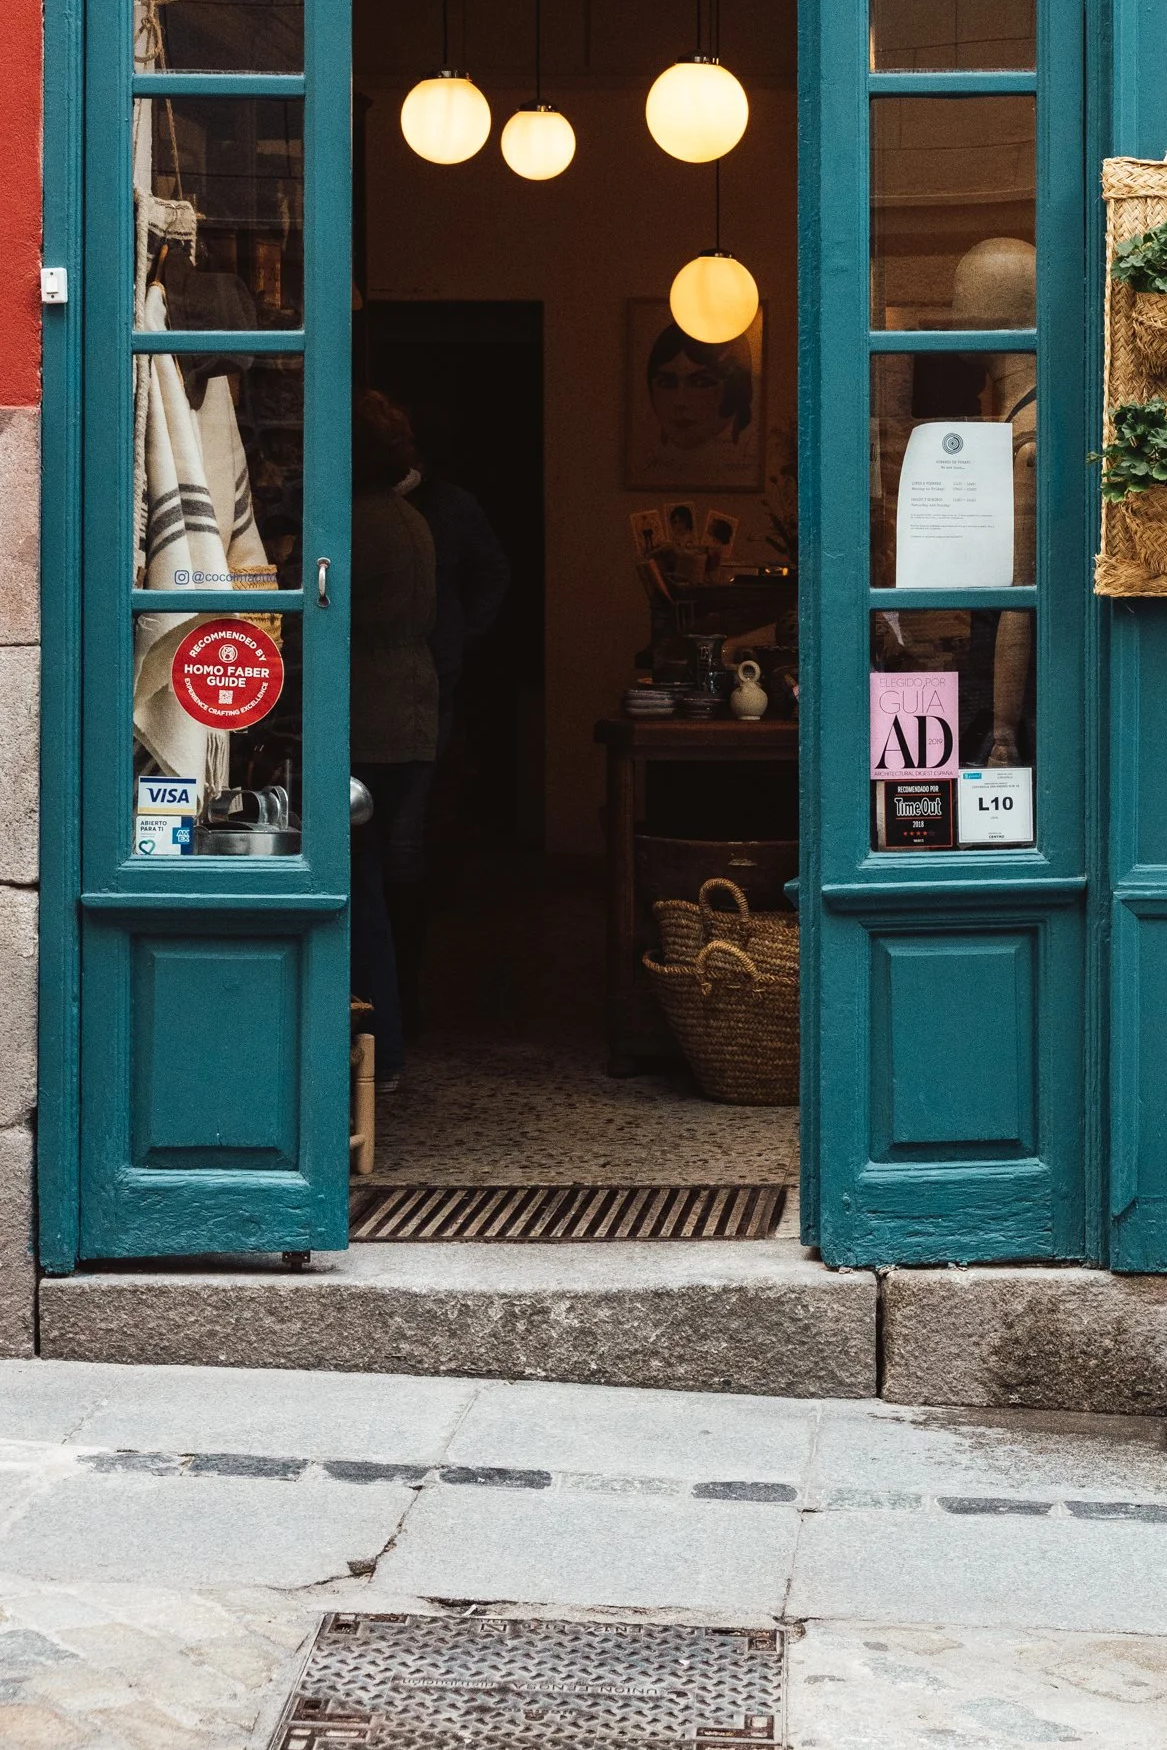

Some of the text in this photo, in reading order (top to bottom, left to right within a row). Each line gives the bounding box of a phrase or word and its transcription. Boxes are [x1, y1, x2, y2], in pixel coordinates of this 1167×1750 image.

[189, 631, 267, 662] RECOMMENDED BY
[184, 664, 270, 678] HOMO FABER
[206, 676, 247, 687] GUIDE
[880, 677, 945, 688] ELEGIDO POR
[184, 677, 269, 717] EXPERIENCE CRAFTING EXCELLENCE
[879, 684, 945, 715] GUÍA
[874, 714, 953, 769] AD
[146, 788, 190, 803] VISA
[978, 796, 1014, 811] L10
[912, 820, 925, 828] 2018
[599, 1685, 658, 1696] UNION
